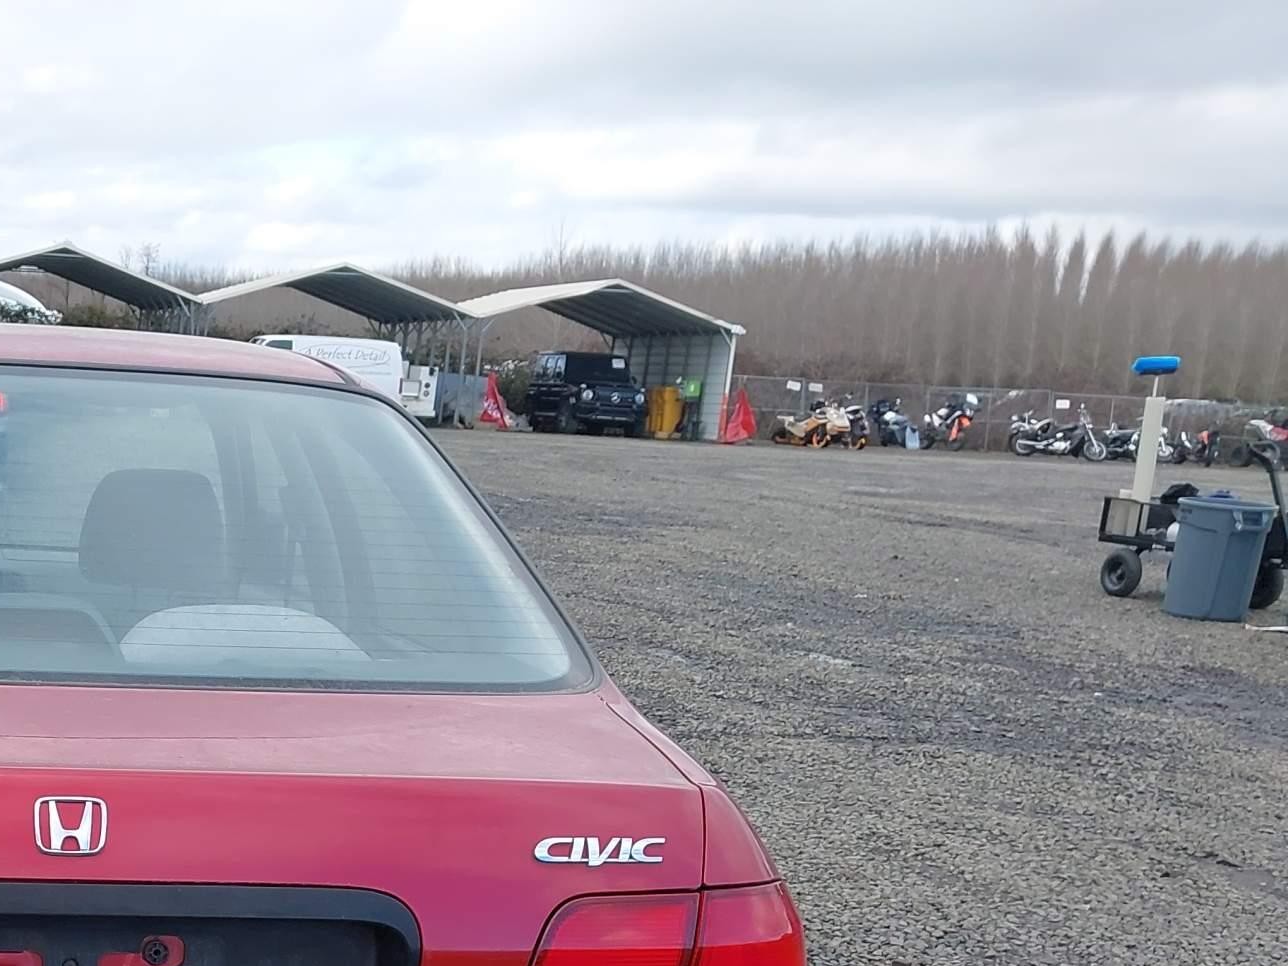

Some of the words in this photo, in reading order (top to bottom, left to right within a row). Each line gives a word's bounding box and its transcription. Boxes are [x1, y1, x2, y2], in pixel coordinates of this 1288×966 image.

[316, 347, 351, 361] Perfect
[355, 348, 387, 362] Detail
[533, 836, 666, 867] CIVIC
